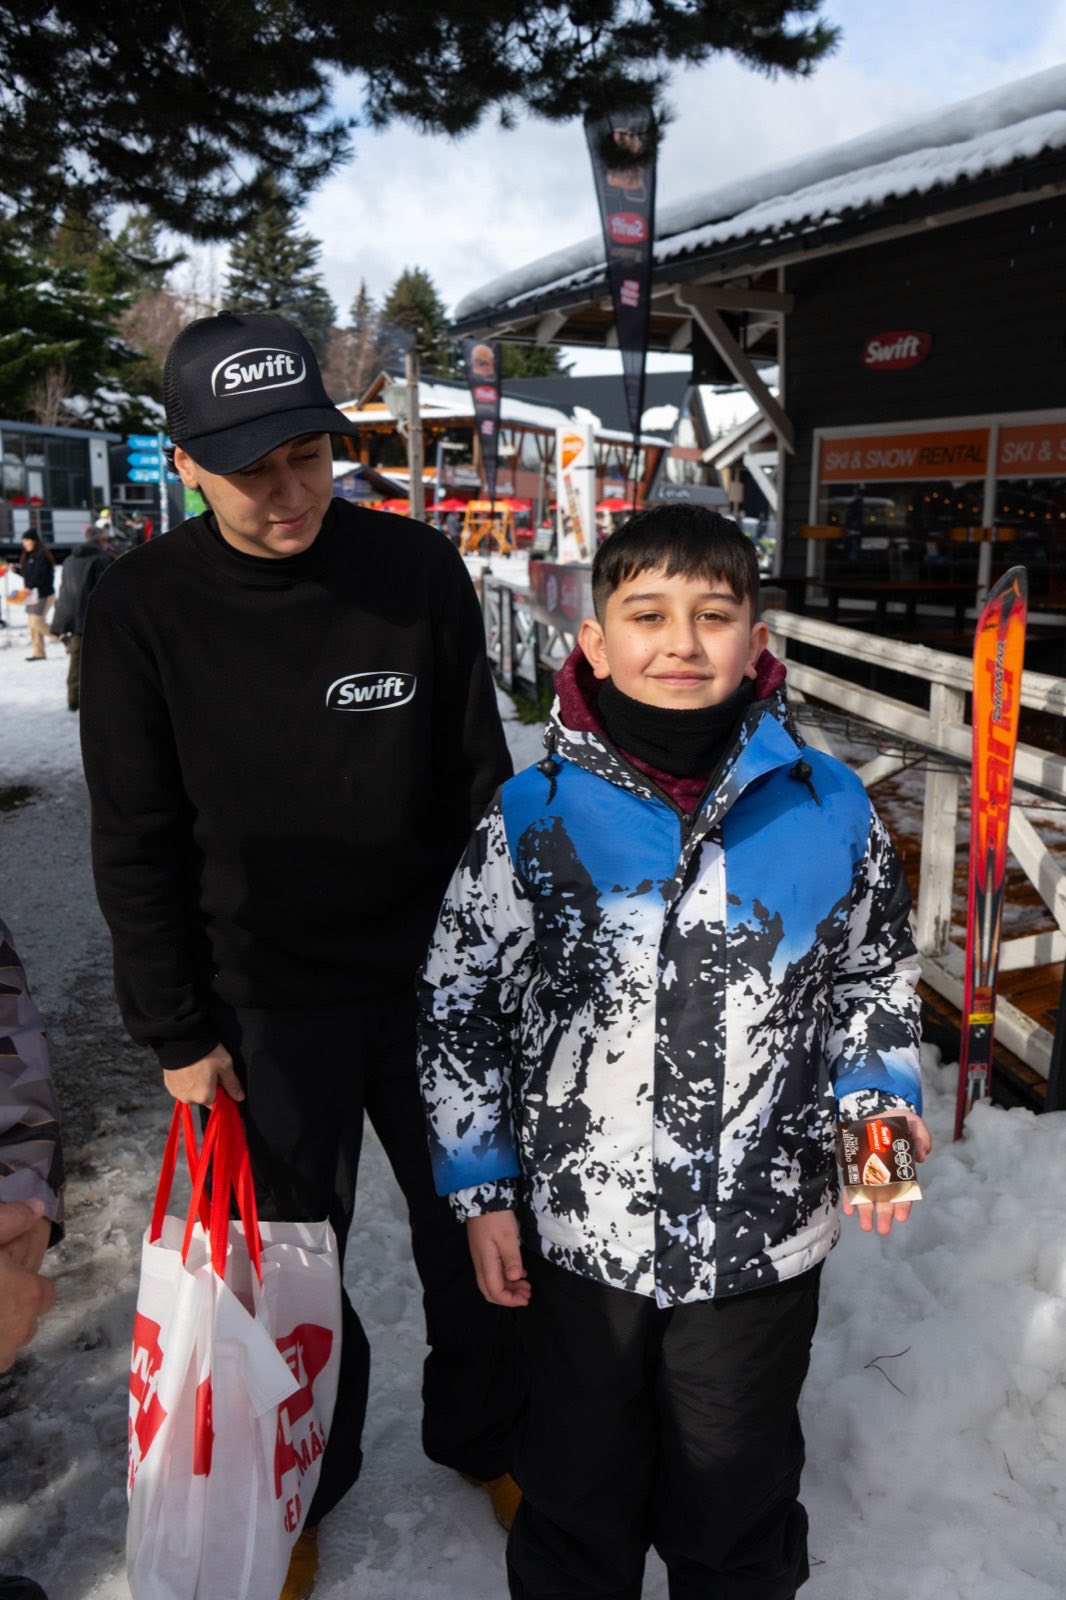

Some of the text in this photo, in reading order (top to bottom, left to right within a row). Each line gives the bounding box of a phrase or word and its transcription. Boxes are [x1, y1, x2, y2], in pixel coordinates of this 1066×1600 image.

[865, 334, 921, 363] Swift
[224, 353, 296, 390] Swift
[825, 443, 985, 471] SKI & SNOW RENTAL
[1002, 441, 1034, 464] SKI
[1037, 440, 1052, 461] &
[337, 676, 405, 705] Swift
[842, 1128, 852, 1162] AHUMADO
[871, 1122, 880, 1150] GOURMET
[881, 1126, 891, 1145] Swift
